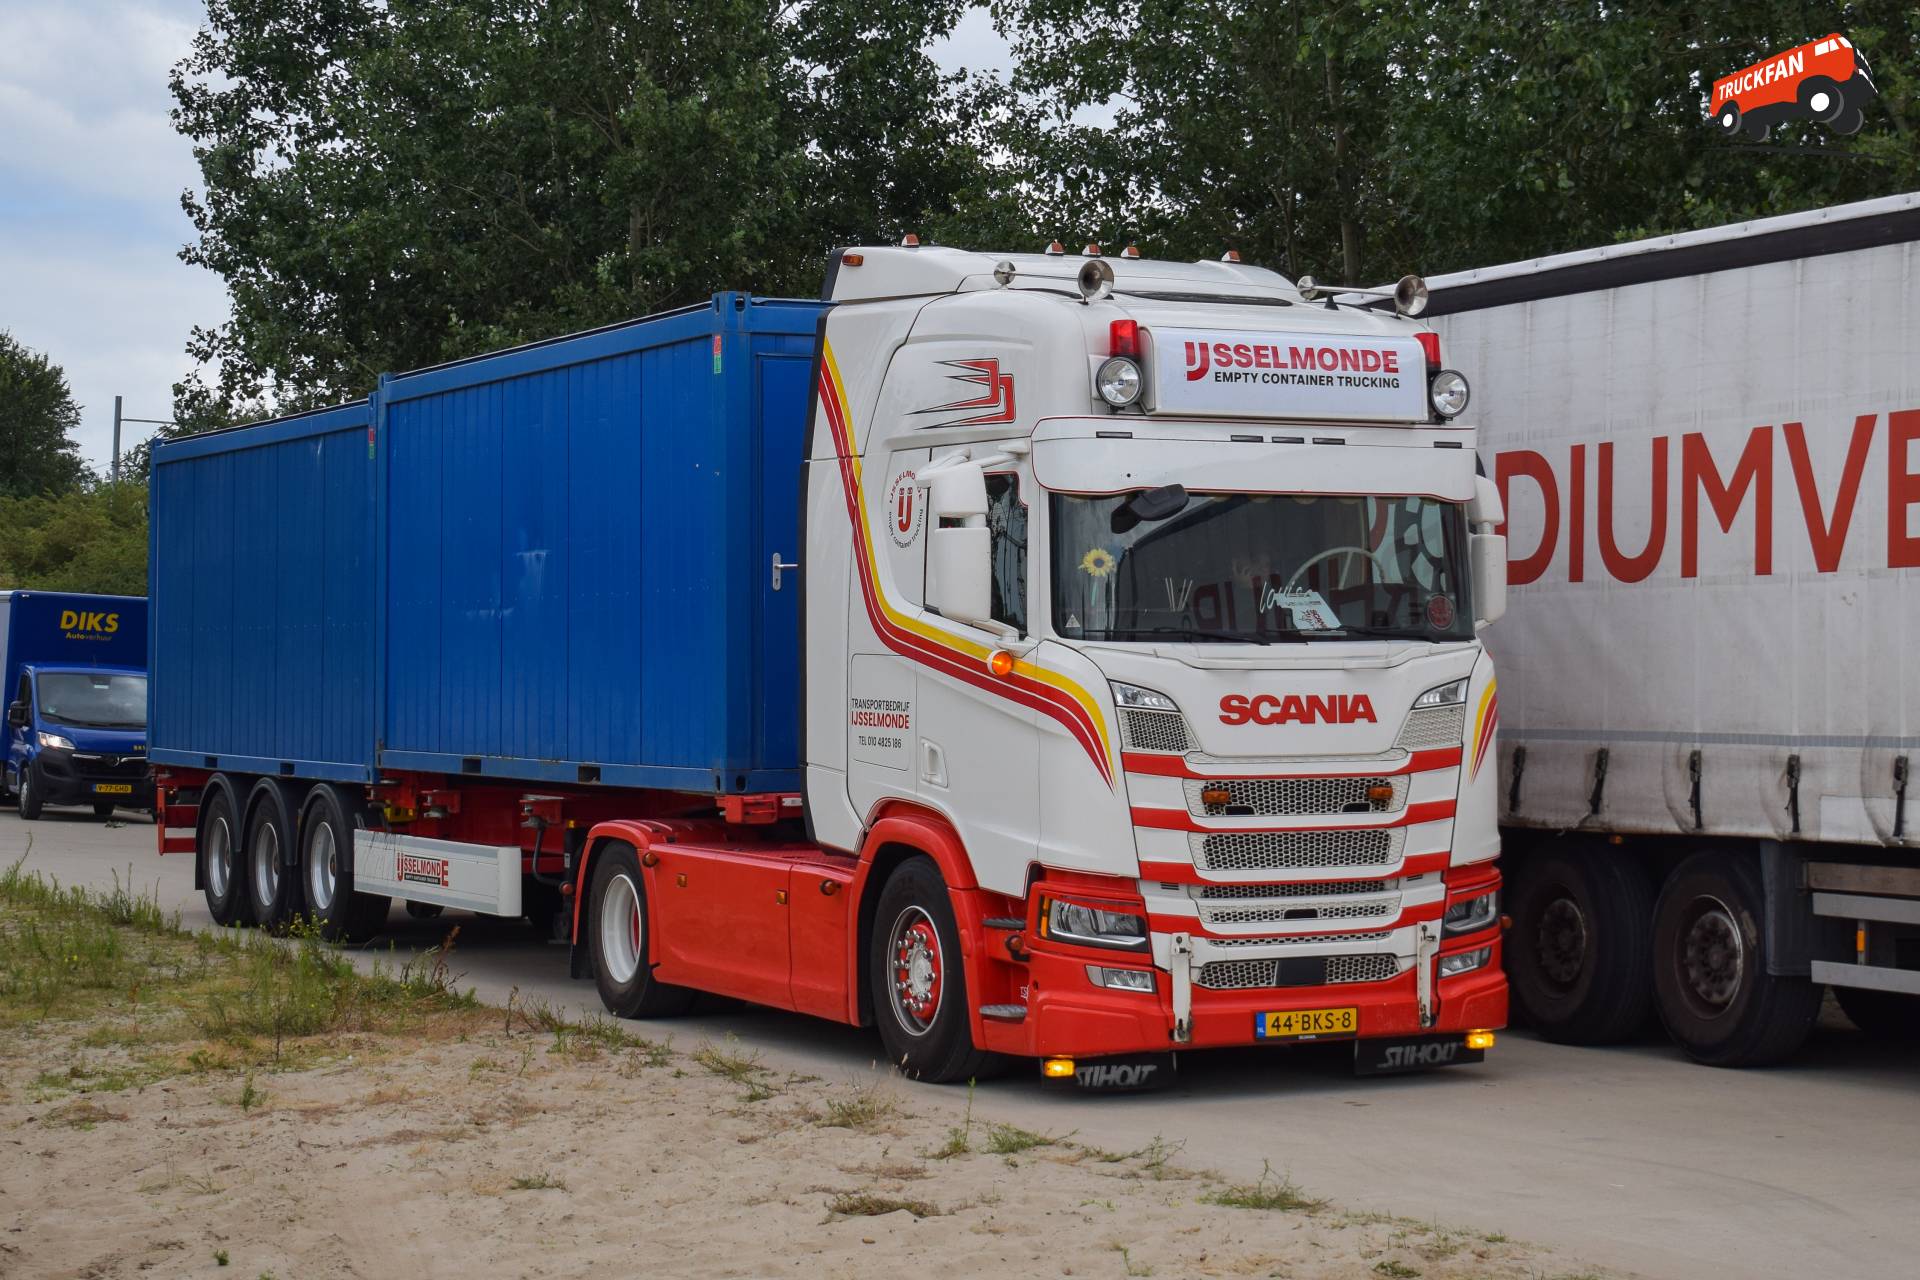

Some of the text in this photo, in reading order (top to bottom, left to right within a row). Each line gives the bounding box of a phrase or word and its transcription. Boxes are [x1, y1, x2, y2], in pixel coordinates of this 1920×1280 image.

[1184, 341, 1400, 382] IJSSELMONDE
[1214, 372, 1400, 389] EMPTY CONTAINER TRUCKING
[60, 610, 120, 633] DIKS
[851, 697, 911, 712] TRANSPORTBEDRIJF
[1218, 694, 1377, 726] SCANIA
[851, 710, 910, 730] IJSSELMONDE
[858, 735, 868, 746] TEL
[867, 735, 877, 746] 010
[1271, 1011, 1352, 1032] 44-BKS-8
